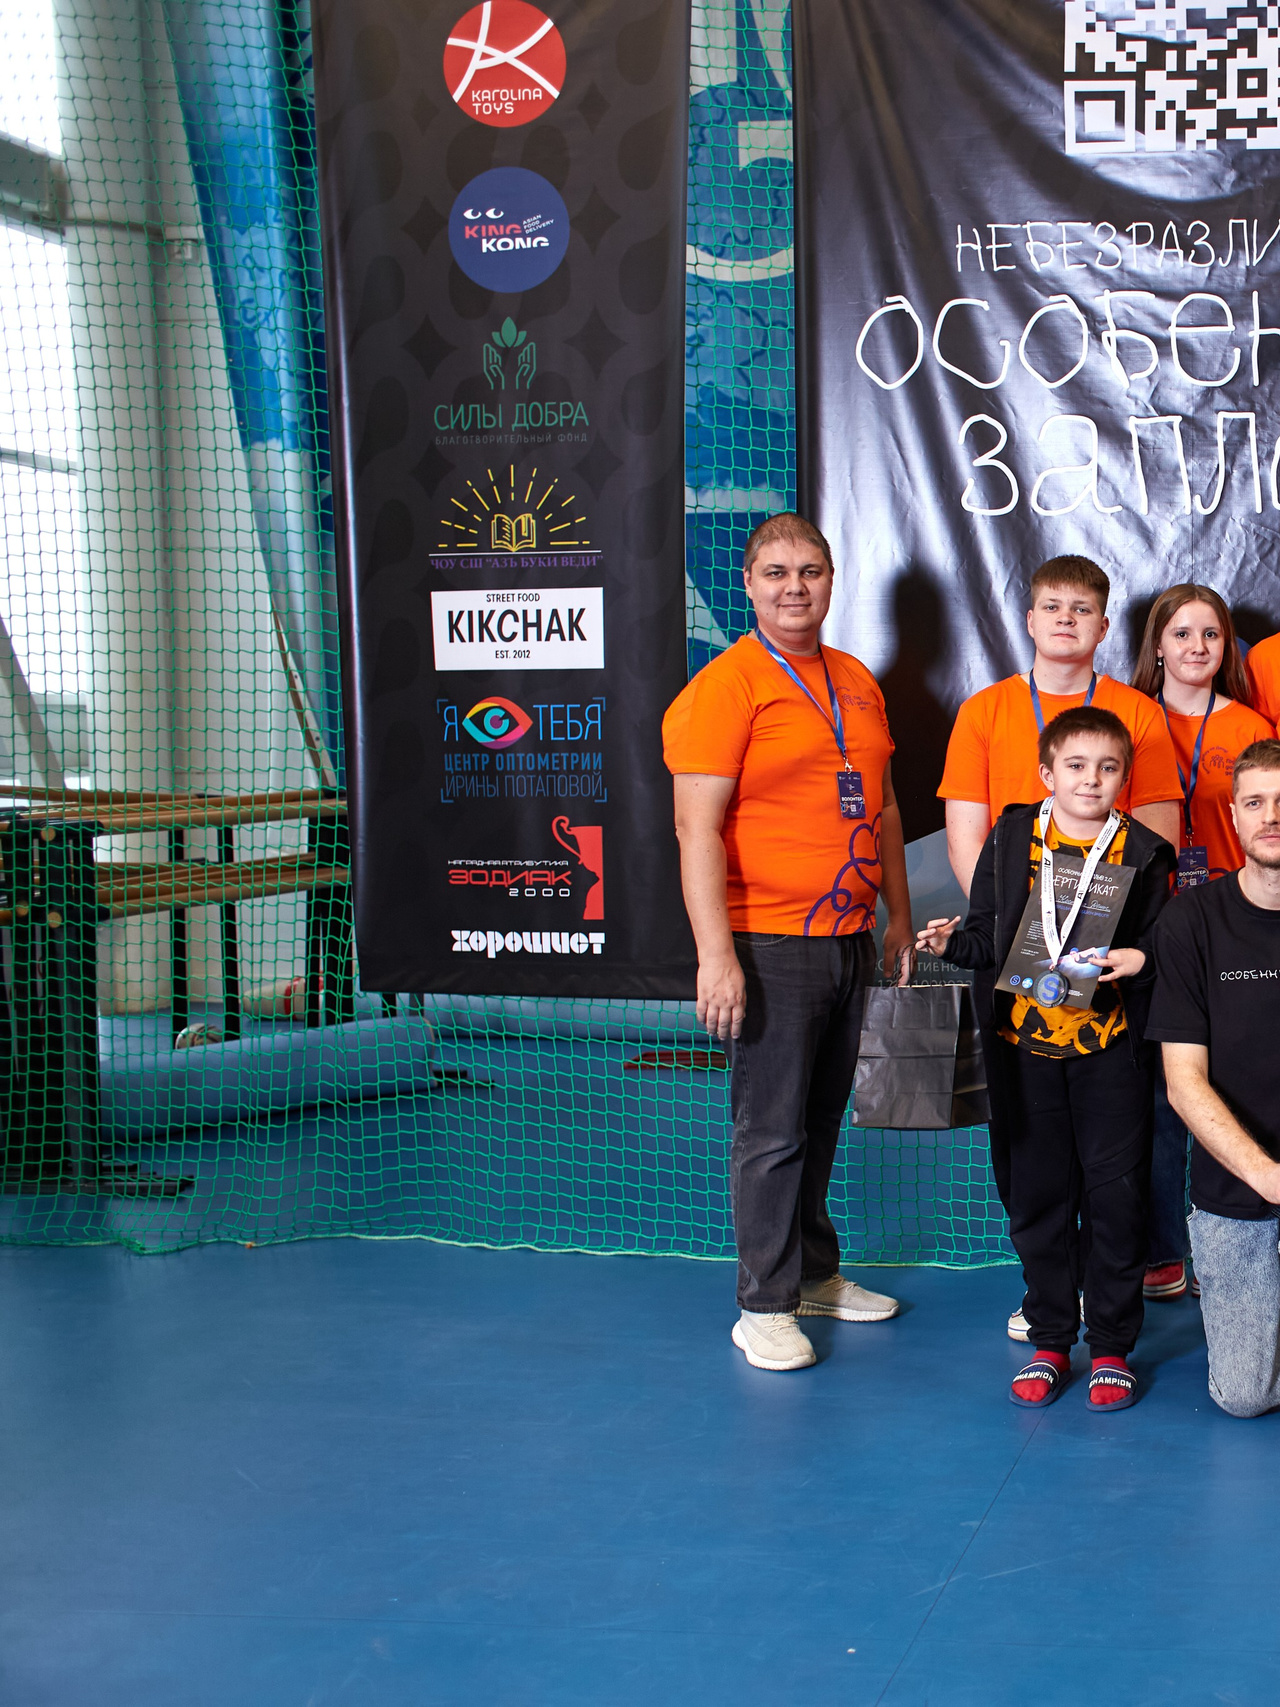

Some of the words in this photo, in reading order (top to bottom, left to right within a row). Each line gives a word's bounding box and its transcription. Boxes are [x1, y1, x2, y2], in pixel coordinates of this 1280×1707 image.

[472, 102, 515, 115] TOYS
[522, 214, 542, 226] ASIAN
[523, 220, 541, 230] FOOD
[525, 219, 555, 234] DELIVERY
[465, 223, 522, 239] KING
[481, 236, 550, 253] KONG
[434, 403, 503, 431] СИЛЫ
[511, 401, 589, 431] ДОБРА
[435, 434, 553, 446] БЛАГОТВОРИТЕЛЬНЫЙ
[557, 433, 588, 444] ФОНД
[430, 558, 457, 569] ЧОУ
[460, 558, 483, 569] СШ
[521, 556, 558, 568] БУКИ
[486, 593, 515, 602] STREET
[518, 593, 540, 602] FOOD
[448, 608, 587, 643] KIKCHAK
[495, 650, 511, 659] EST.
[513, 650, 531, 659] 2012
[443, 705, 459, 742] Я
[532, 704, 602, 741] ТЕБЯ
[444, 754, 490, 772] ЦЕНТР
[496, 752, 602, 771] ОПТОМЕТРИИ
[445, 775, 499, 797] ИРИНЫ
[504, 771, 603, 797] ПОТАПОВОЙ
[448, 869, 572, 888] ЗОДИАК
[1053, 874, 1119, 897] ЕРТИИКАТ
[508, 888, 571, 897] 2000
